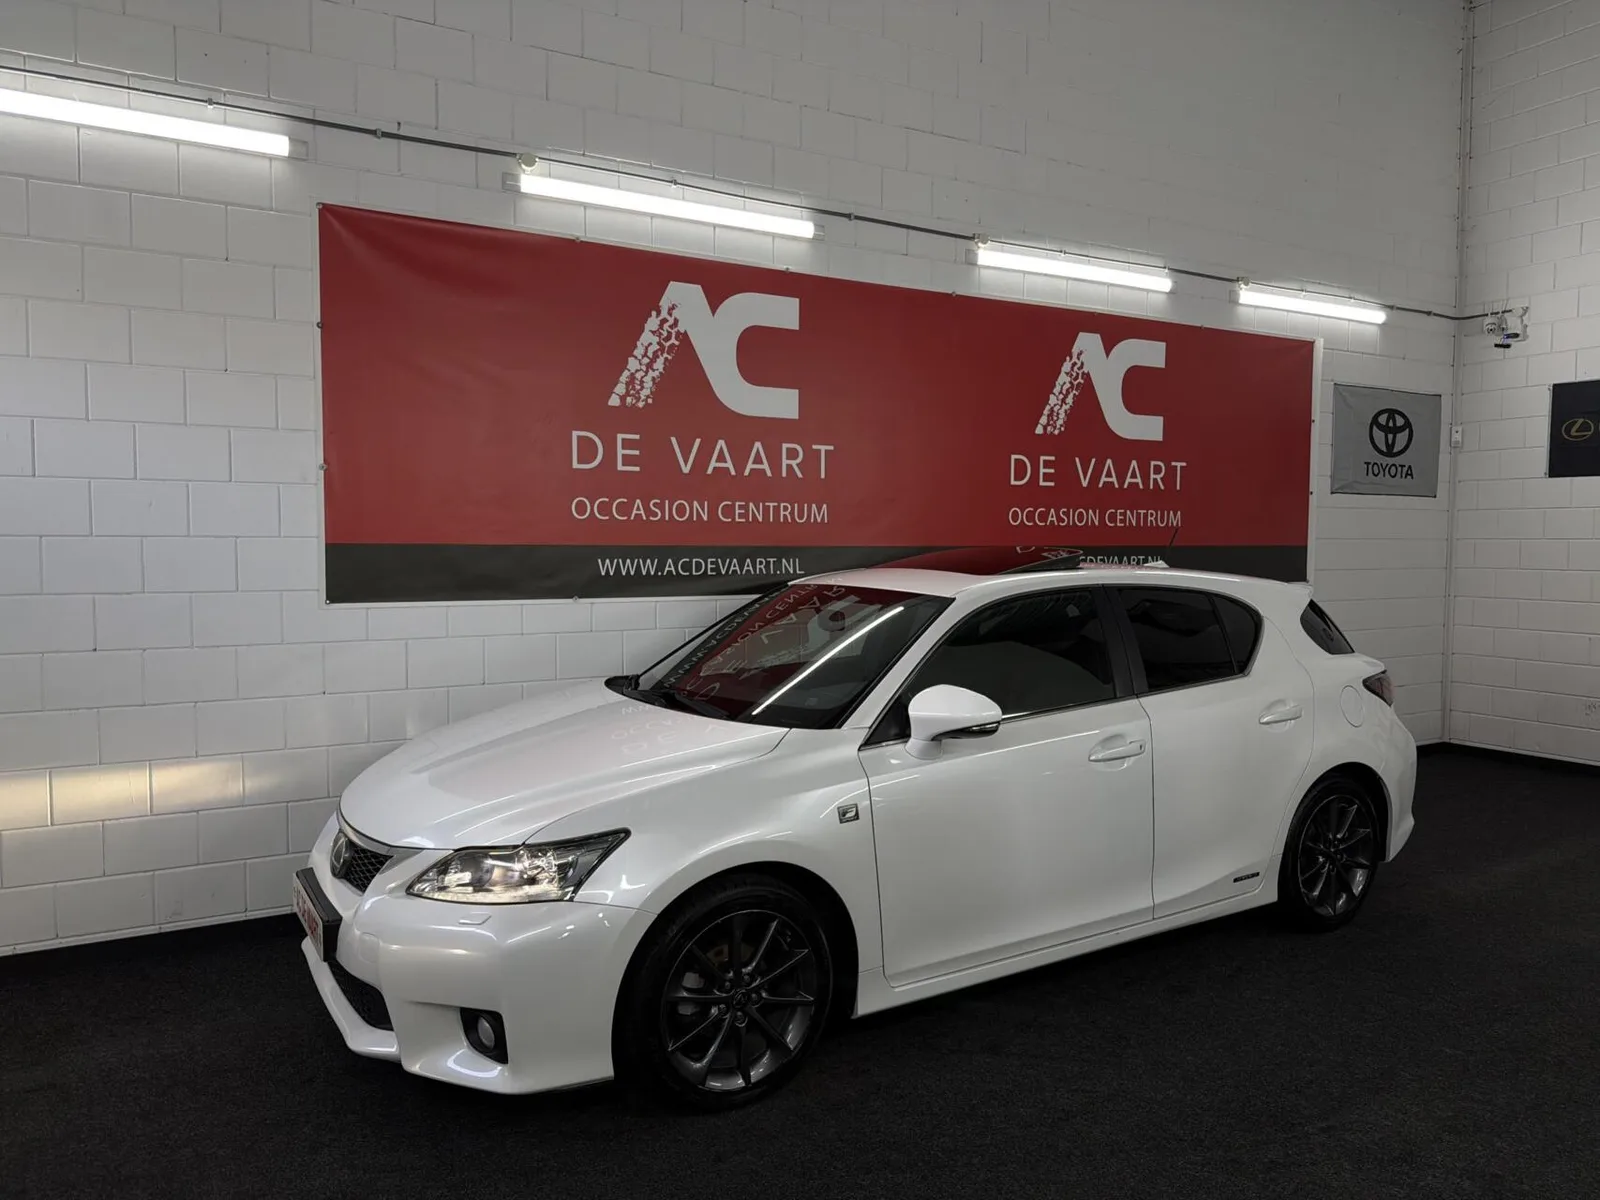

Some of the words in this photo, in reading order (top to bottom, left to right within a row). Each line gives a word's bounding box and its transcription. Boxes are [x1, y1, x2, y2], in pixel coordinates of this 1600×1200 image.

[608, 281, 800, 420] AC
[1035, 332, 1166, 442] AC
[571, 430, 641, 472] DE
[670, 436, 835, 479] VAART
[1364, 461, 1414, 480] TOYOTA
[1010, 454, 1055, 487] DE
[1075, 457, 1187, 490] VAART
[571, 496, 708, 522] OCCASION
[717, 501, 828, 524] CENTRUM
[1008, 507, 1099, 526] OCCASION
[1105, 509, 1181, 527] CENTRUM
[597, 557, 805, 577] WWW.ACDEVAART.NL
